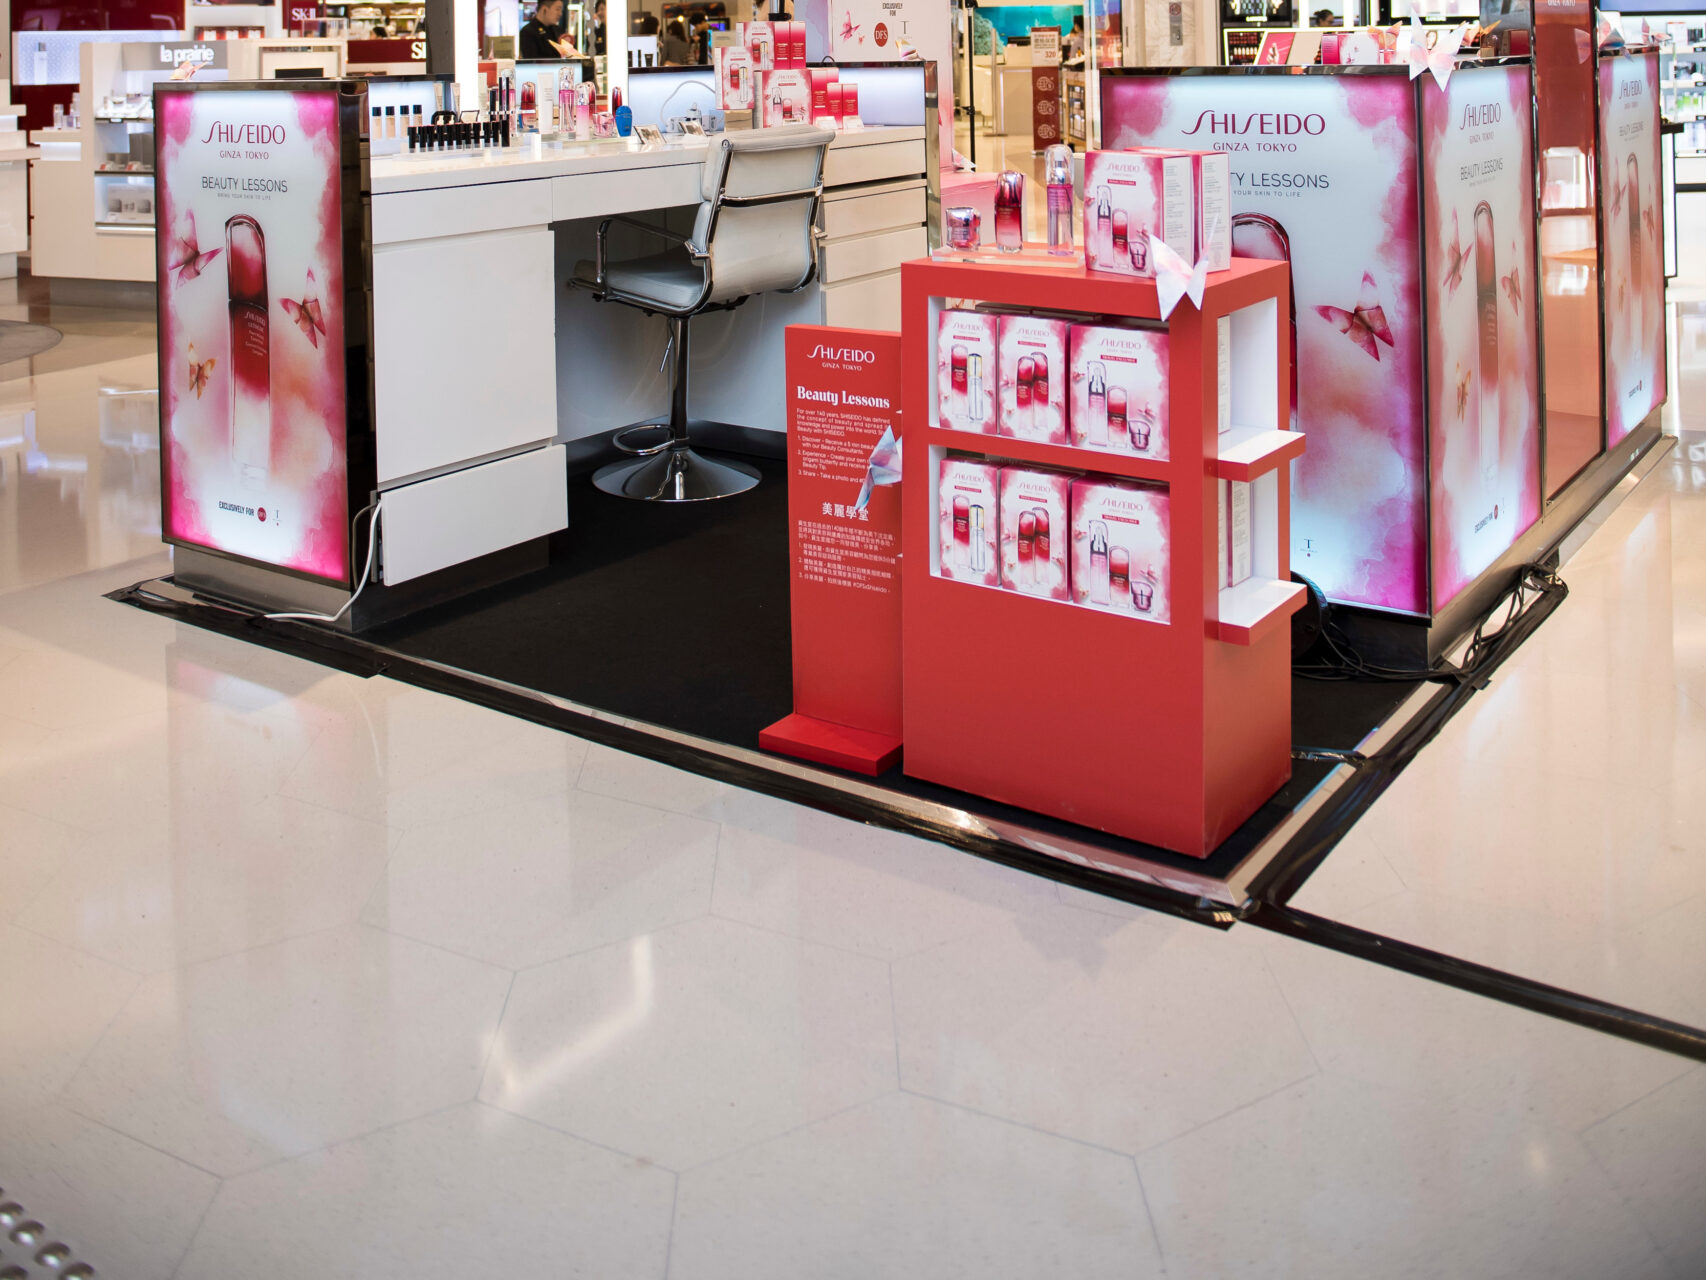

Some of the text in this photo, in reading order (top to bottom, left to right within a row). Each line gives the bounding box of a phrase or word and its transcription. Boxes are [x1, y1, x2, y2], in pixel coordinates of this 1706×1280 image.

[875, 30, 889, 40] DFS
[160, 45, 215, 67] la prairie
[1180, 109, 1326, 136] SHISEIDO
[1459, 102, 1501, 131] SHISEIDO
[201, 120, 286, 144] SHISEIDO
[219, 150, 270, 160] GINZA TOKYO
[1213, 141, 1297, 152] GINZA TOKYO
[1460, 163, 1480, 181] BEAUTY
[1480, 157, 1503, 176] LESSONS
[202, 176, 288, 193] BEAUTY LESSONS
[1251, 173, 1330, 189] LESSONS
[806, 344, 876, 364] SHISEIDO
[842, 364, 862, 372] TOKYO
[797, 385, 890, 409] Beauty Lessons
[219, 501, 246, 515] EXCLUSIVELY
[245, 507, 255, 517] FOR
[822, 502, 869, 521] 美麗學堂
